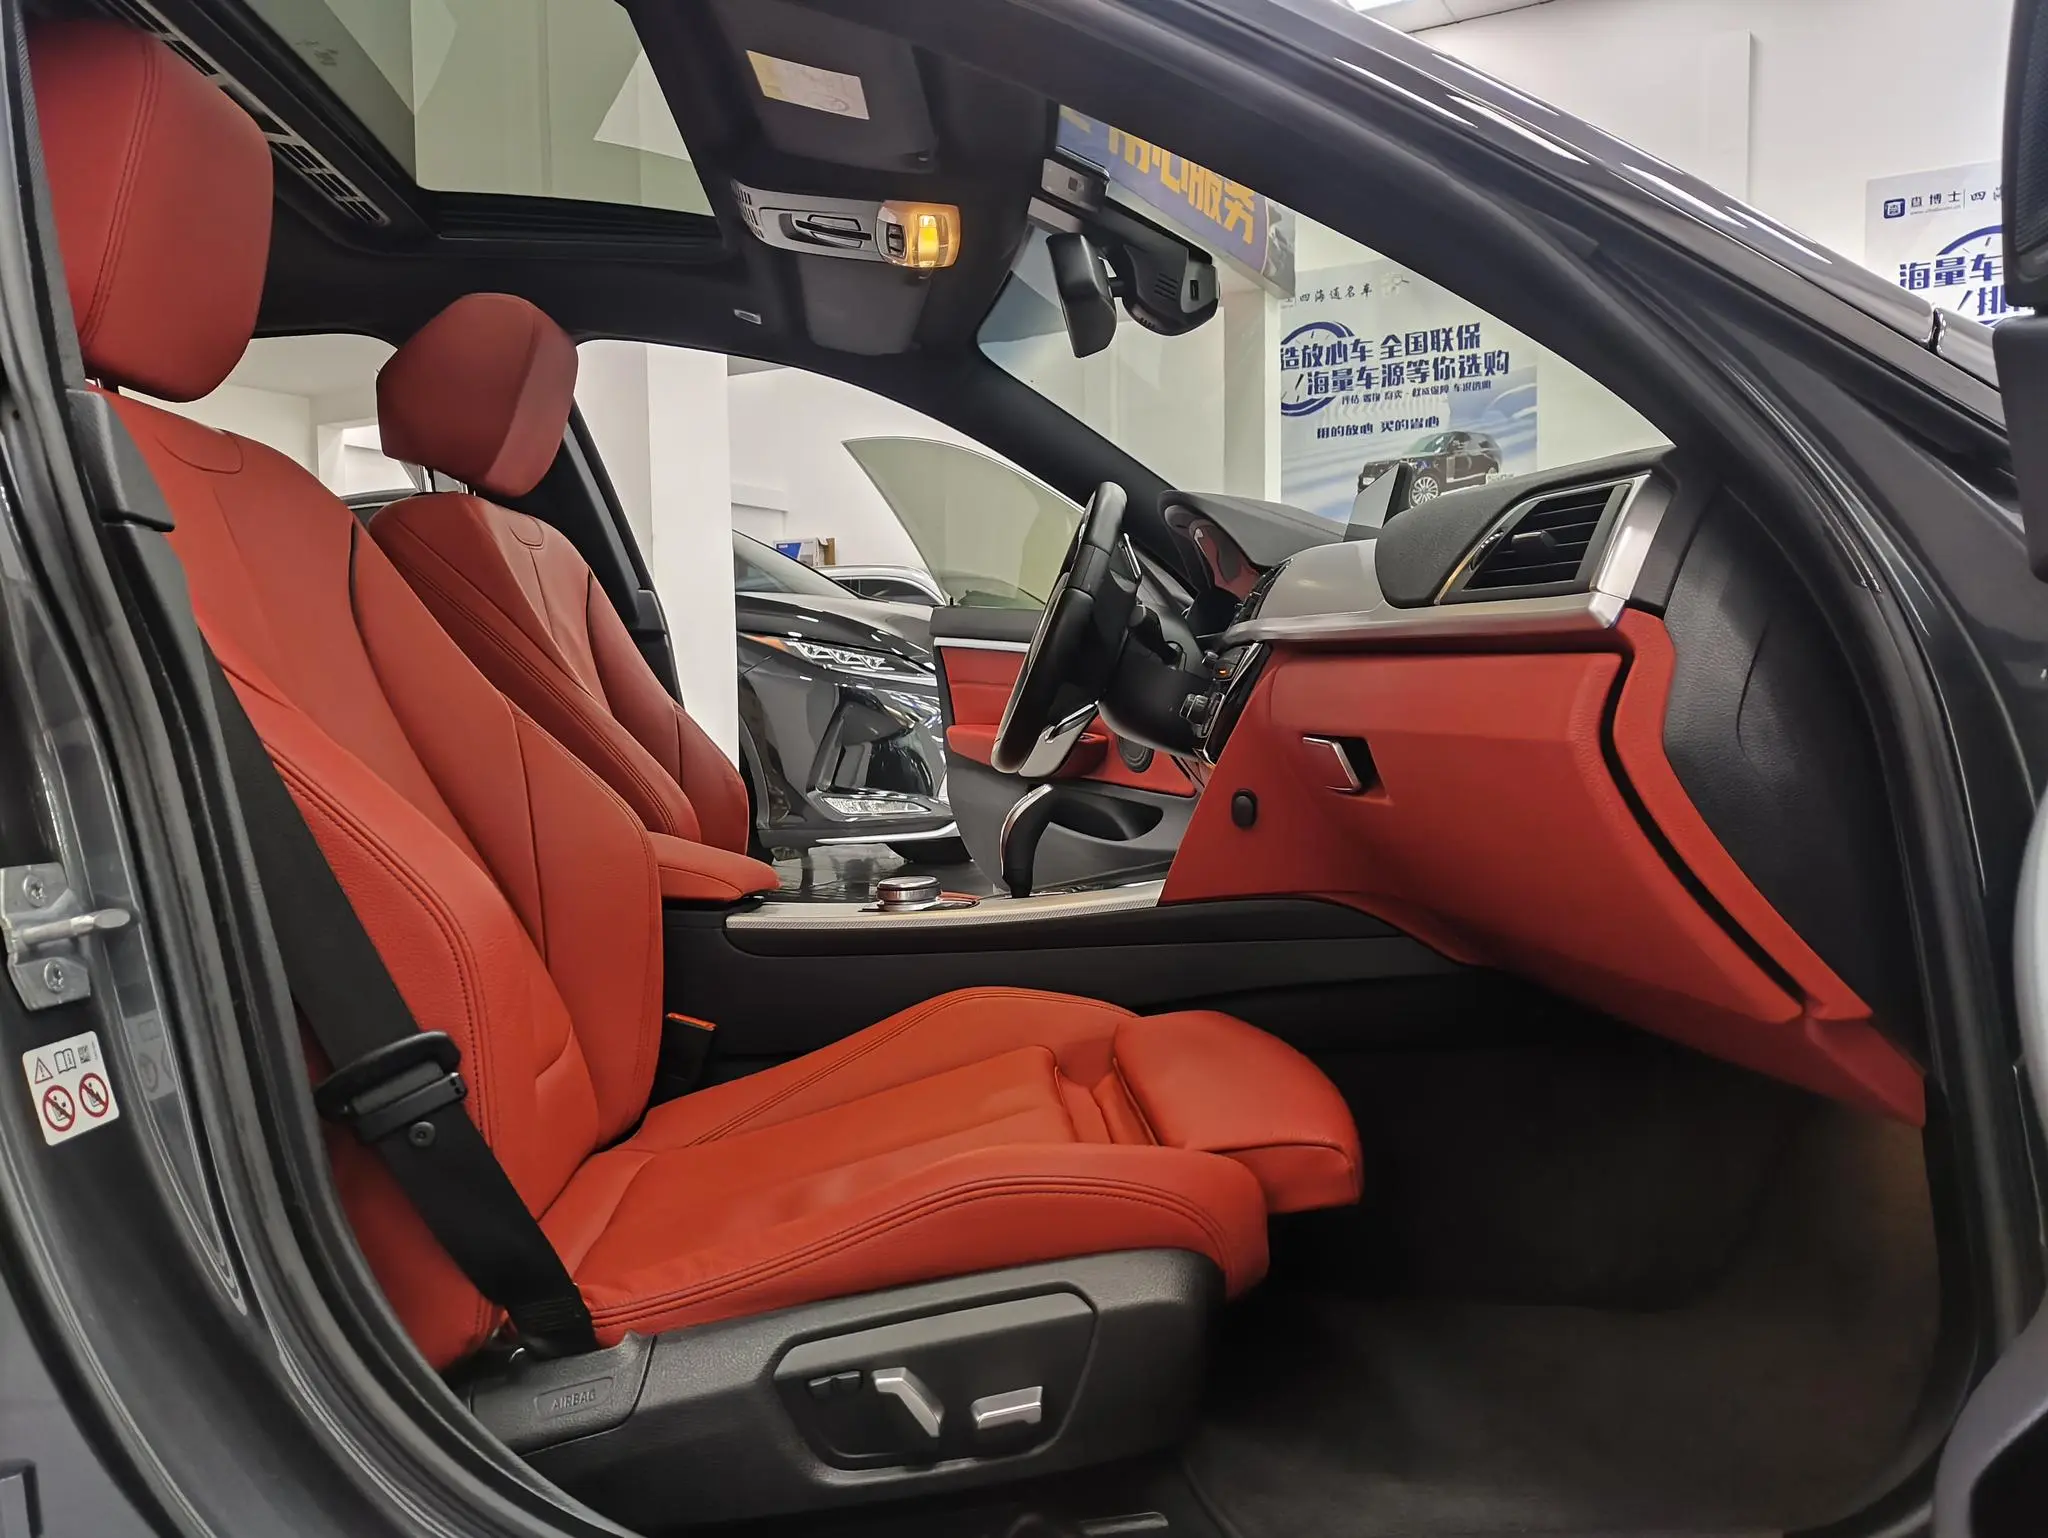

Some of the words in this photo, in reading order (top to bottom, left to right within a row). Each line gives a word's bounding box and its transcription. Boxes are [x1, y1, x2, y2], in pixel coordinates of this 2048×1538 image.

[1379, 322, 1481, 360] 全国联保
[1307, 350, 1510, 396] 海量车源等你选购
[551, 1389, 596, 1410] AIRBAG
